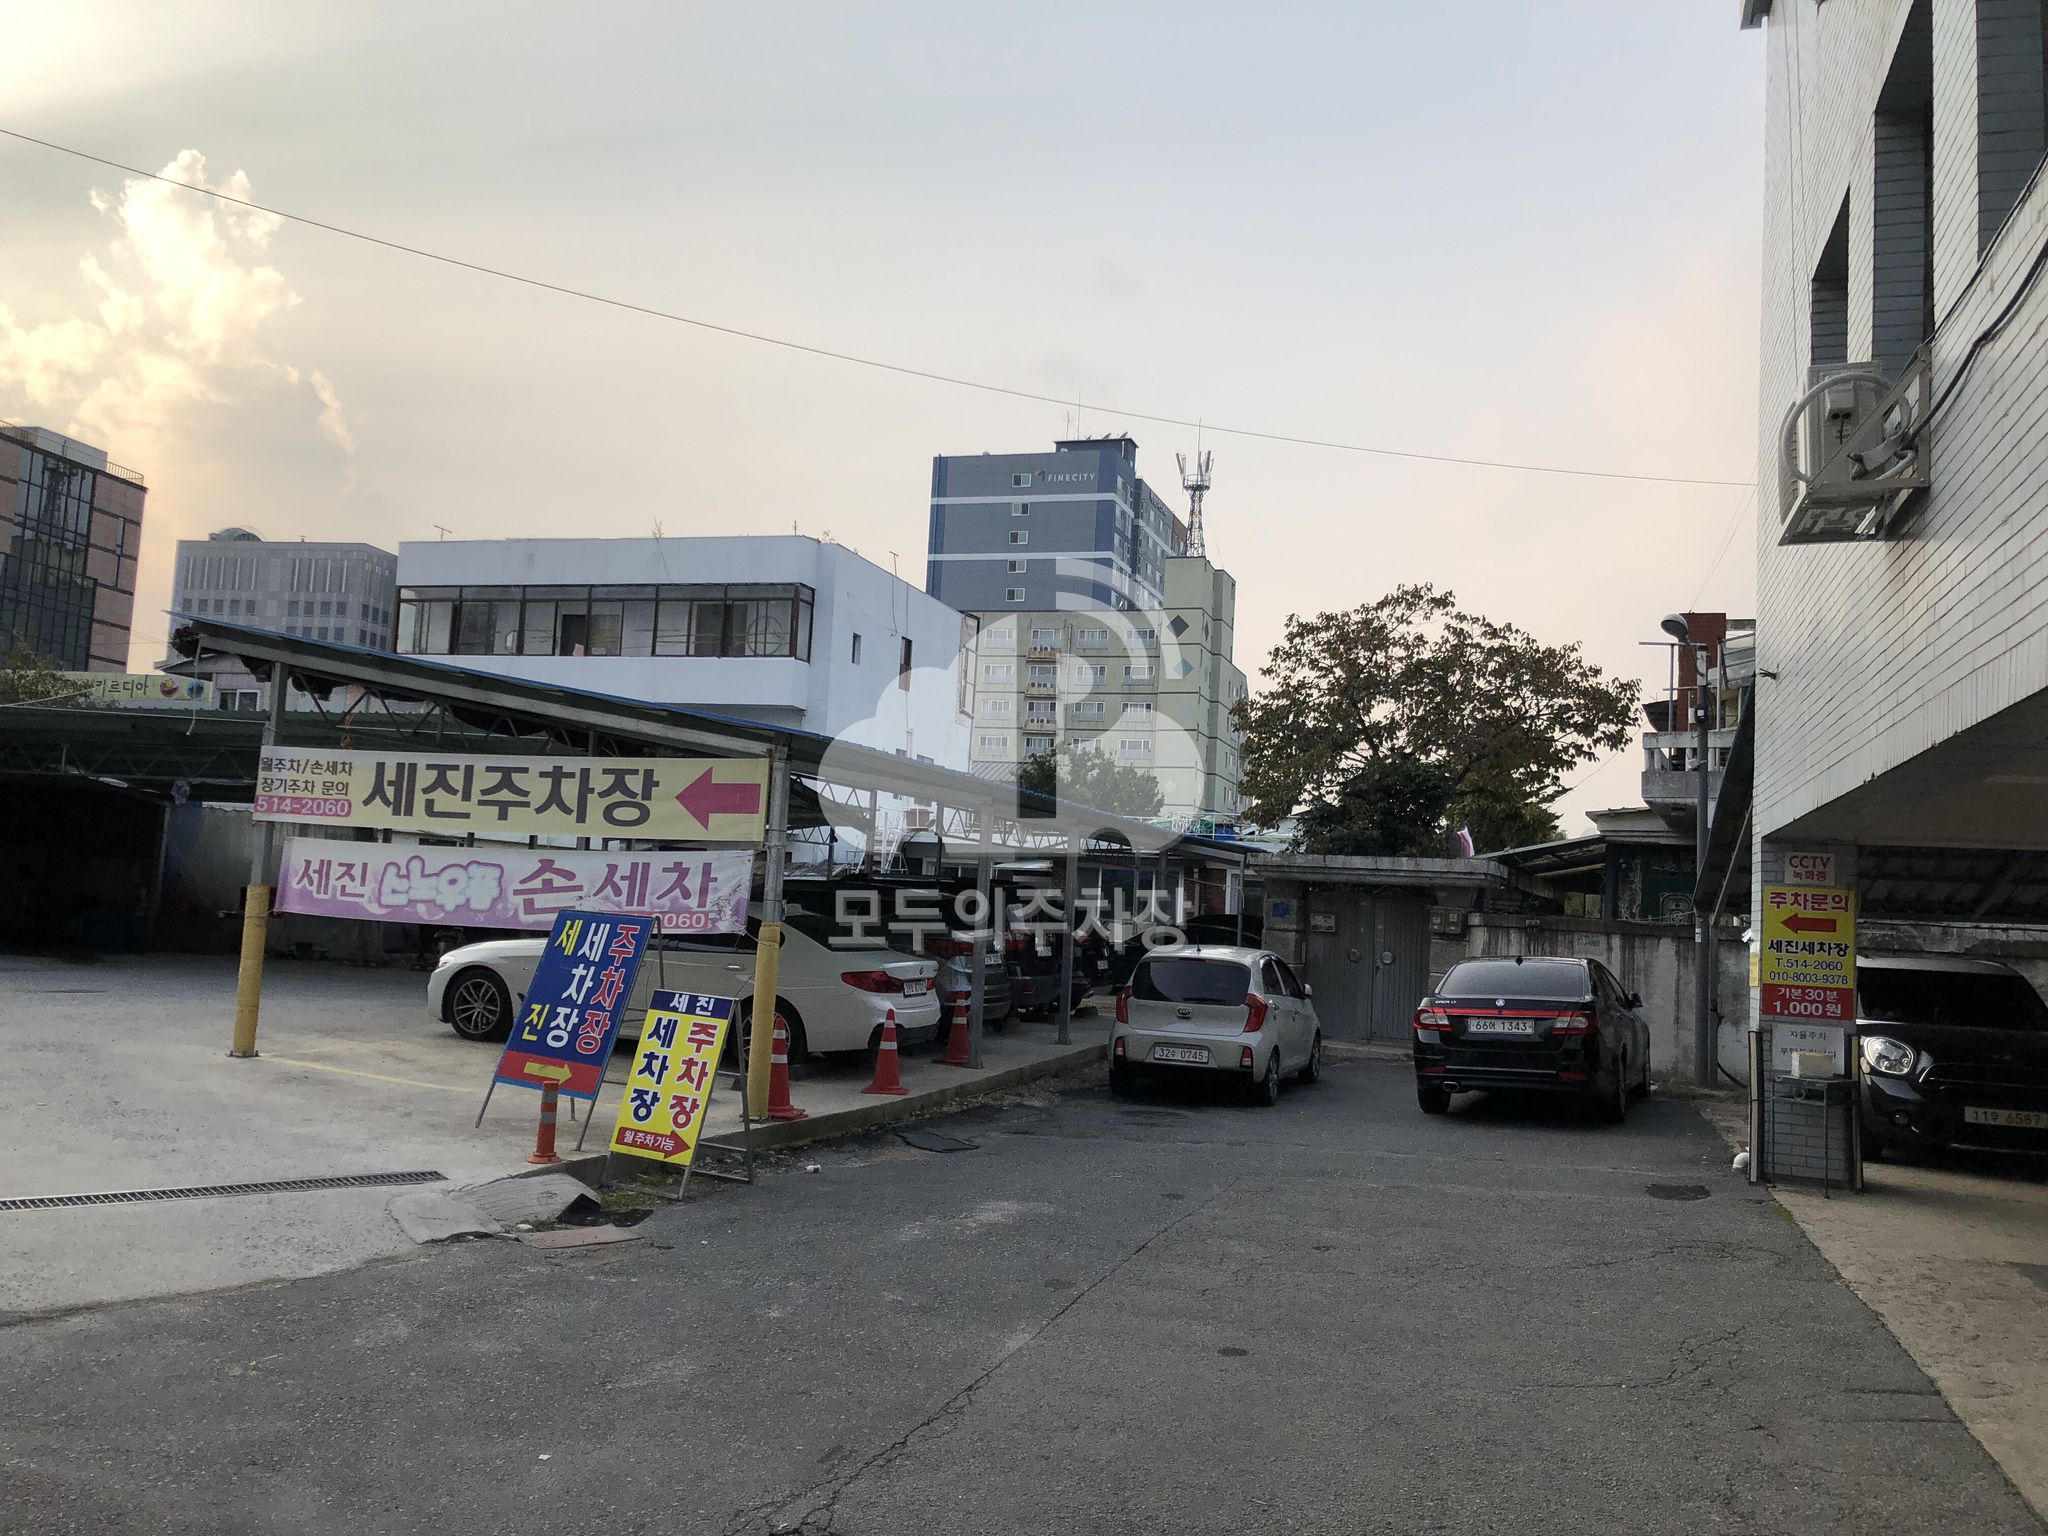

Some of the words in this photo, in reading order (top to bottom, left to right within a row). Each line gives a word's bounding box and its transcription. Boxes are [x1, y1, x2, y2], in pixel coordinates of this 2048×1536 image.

[1048, 473, 1096, 482] FINECITY
[260, 757, 354, 777] 월주차/손세차
[261, 777, 316, 796] 장기주차
[321, 780, 349, 797] 문의
[362, 761, 660, 828] 세진주차장
[256, 797, 349, 817] 514-2060
[1789, 855, 1831, 869] CCTV
[296, 859, 369, 899] 세진
[1769, 891, 1849, 912] 주차문의
[1768, 939, 1849, 957] 세진세차장
[1775, 958, 1843, 971] T.514-2060
[1769, 971, 1848, 985] 010-8003-9378
[1501, 1020, 1527, 1031] 1343
[1180, 1050, 1204, 1060] 0745
[629, 1017, 679, 1122] 세차장
[669, 1021, 719, 1129] 주차장
